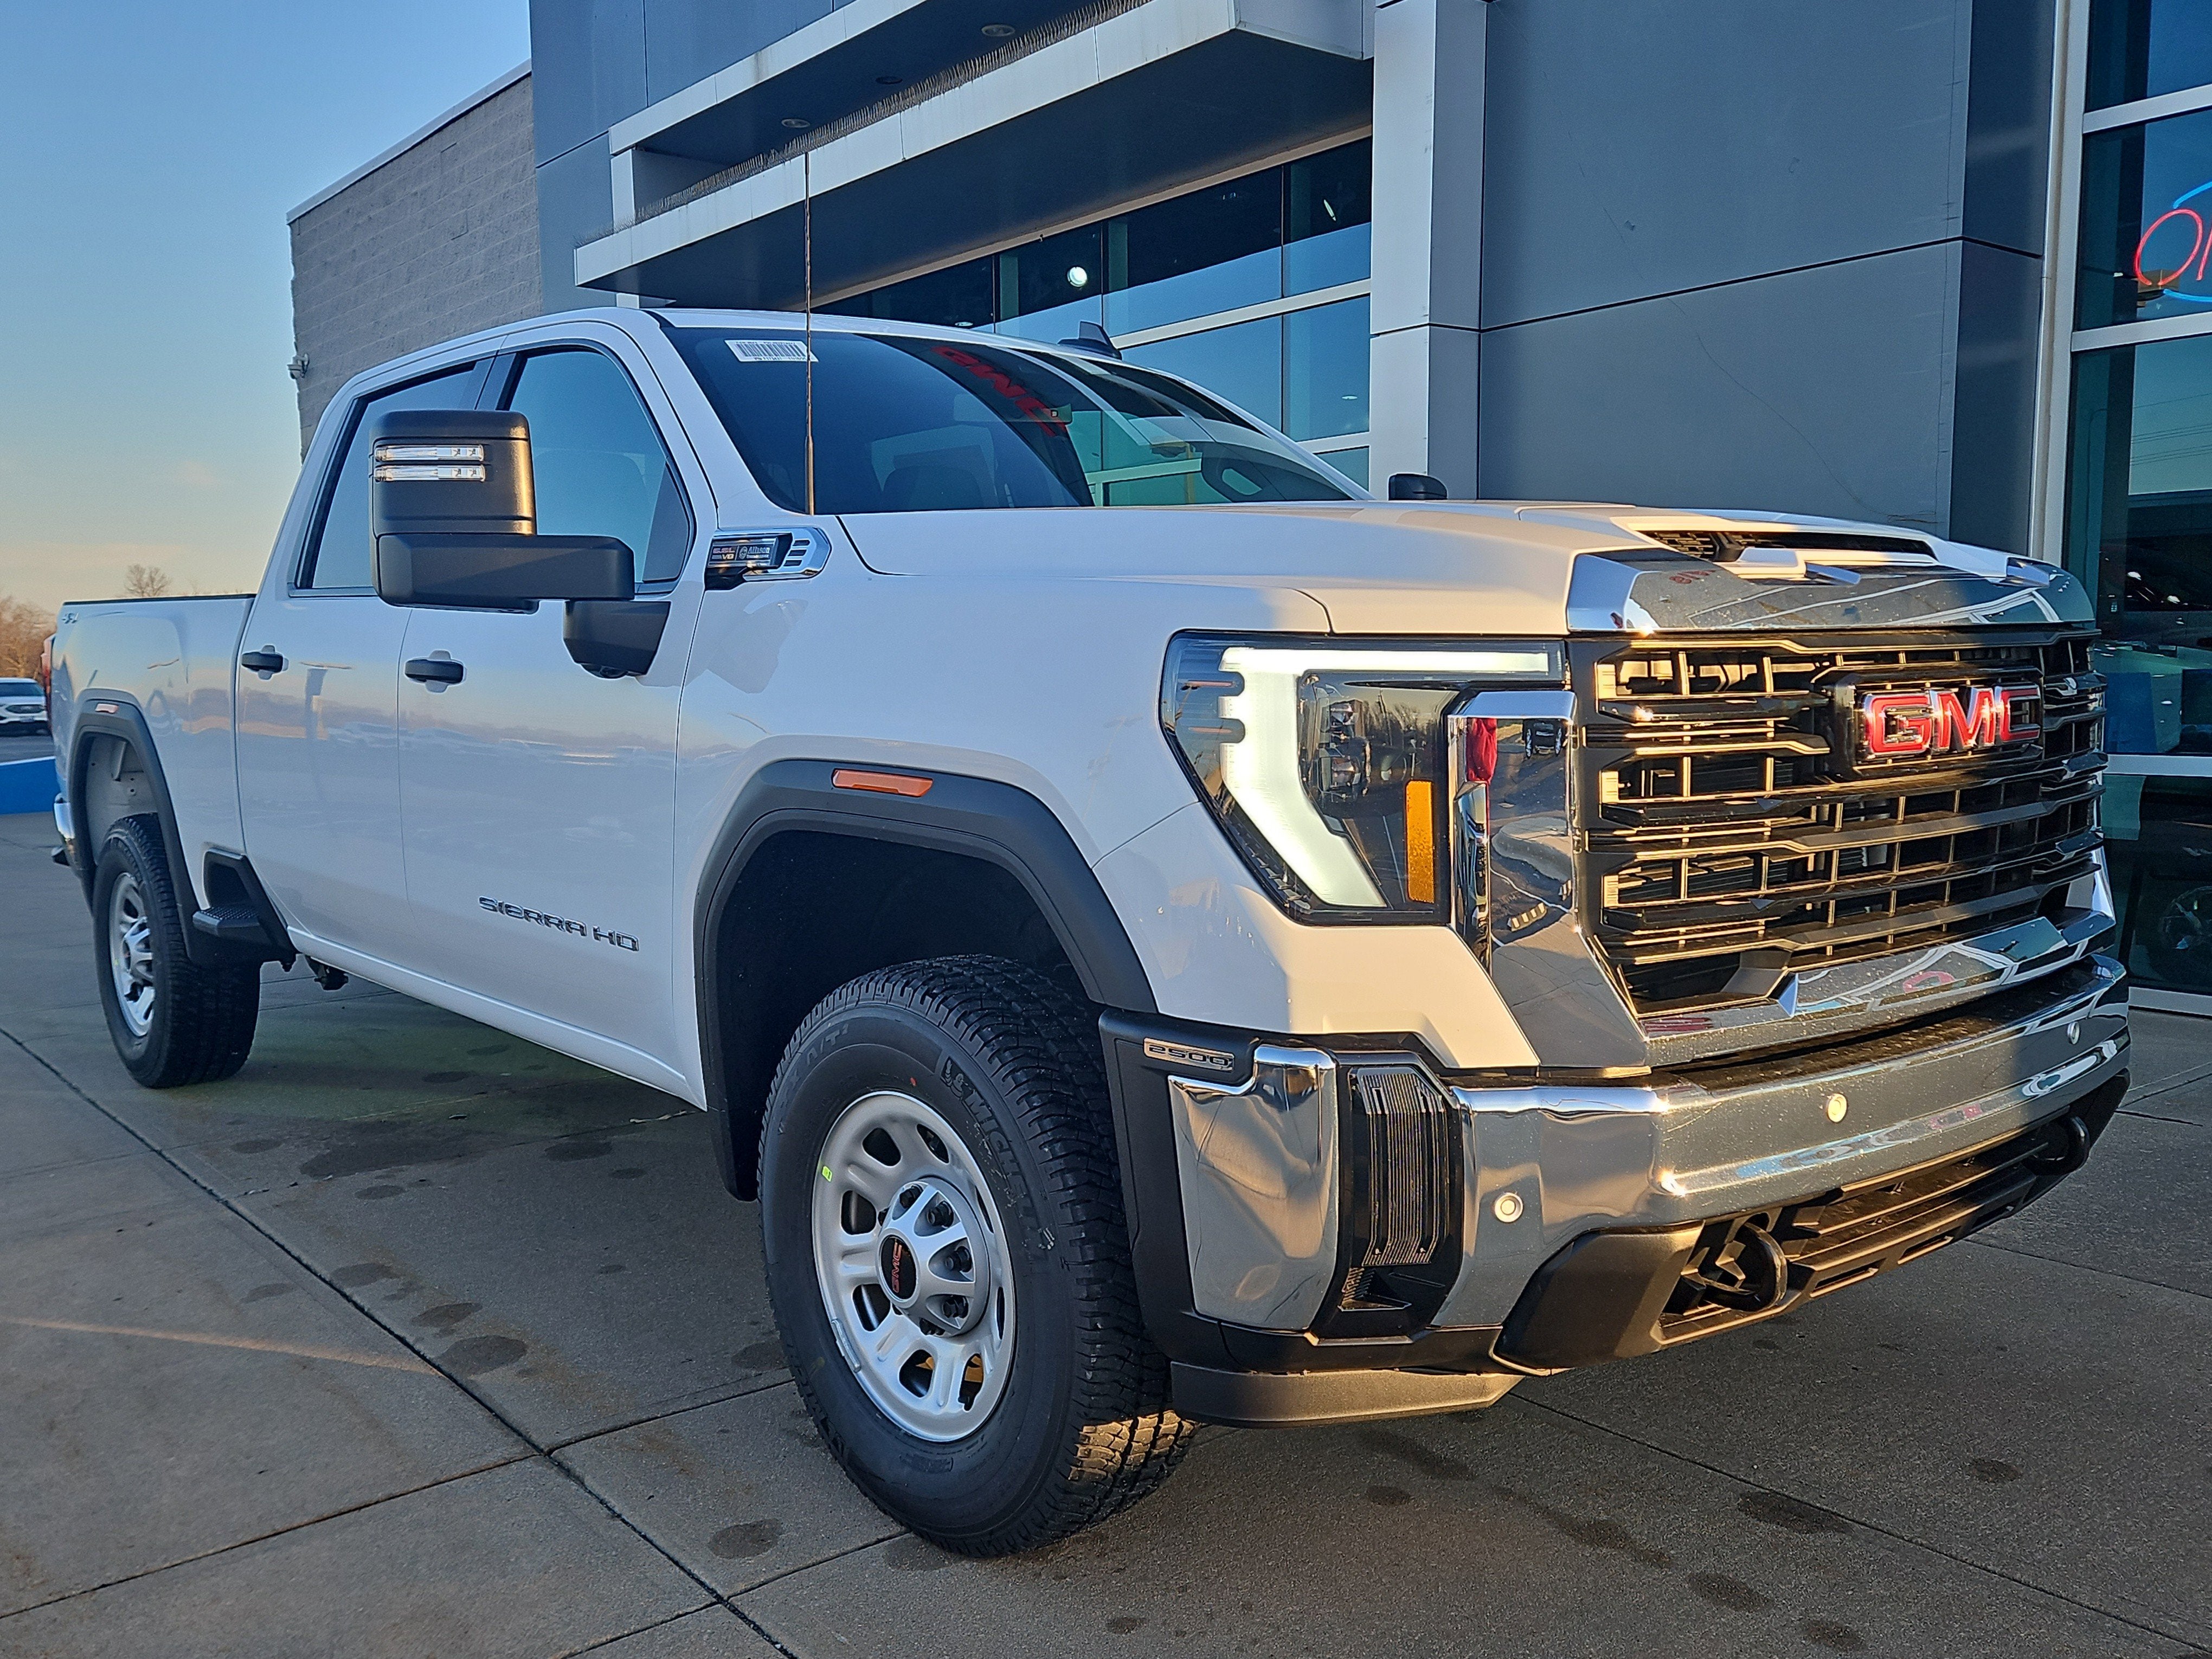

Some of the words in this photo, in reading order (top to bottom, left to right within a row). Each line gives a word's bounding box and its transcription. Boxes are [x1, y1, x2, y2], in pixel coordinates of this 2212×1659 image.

[1863, 683, 2041, 755] GMC
[479, 896, 588, 937] SIERRA
[592, 925, 640, 951] HD
[1149, 1045, 1229, 1066] 2500
[892, 1242, 902, 1293] GMC
